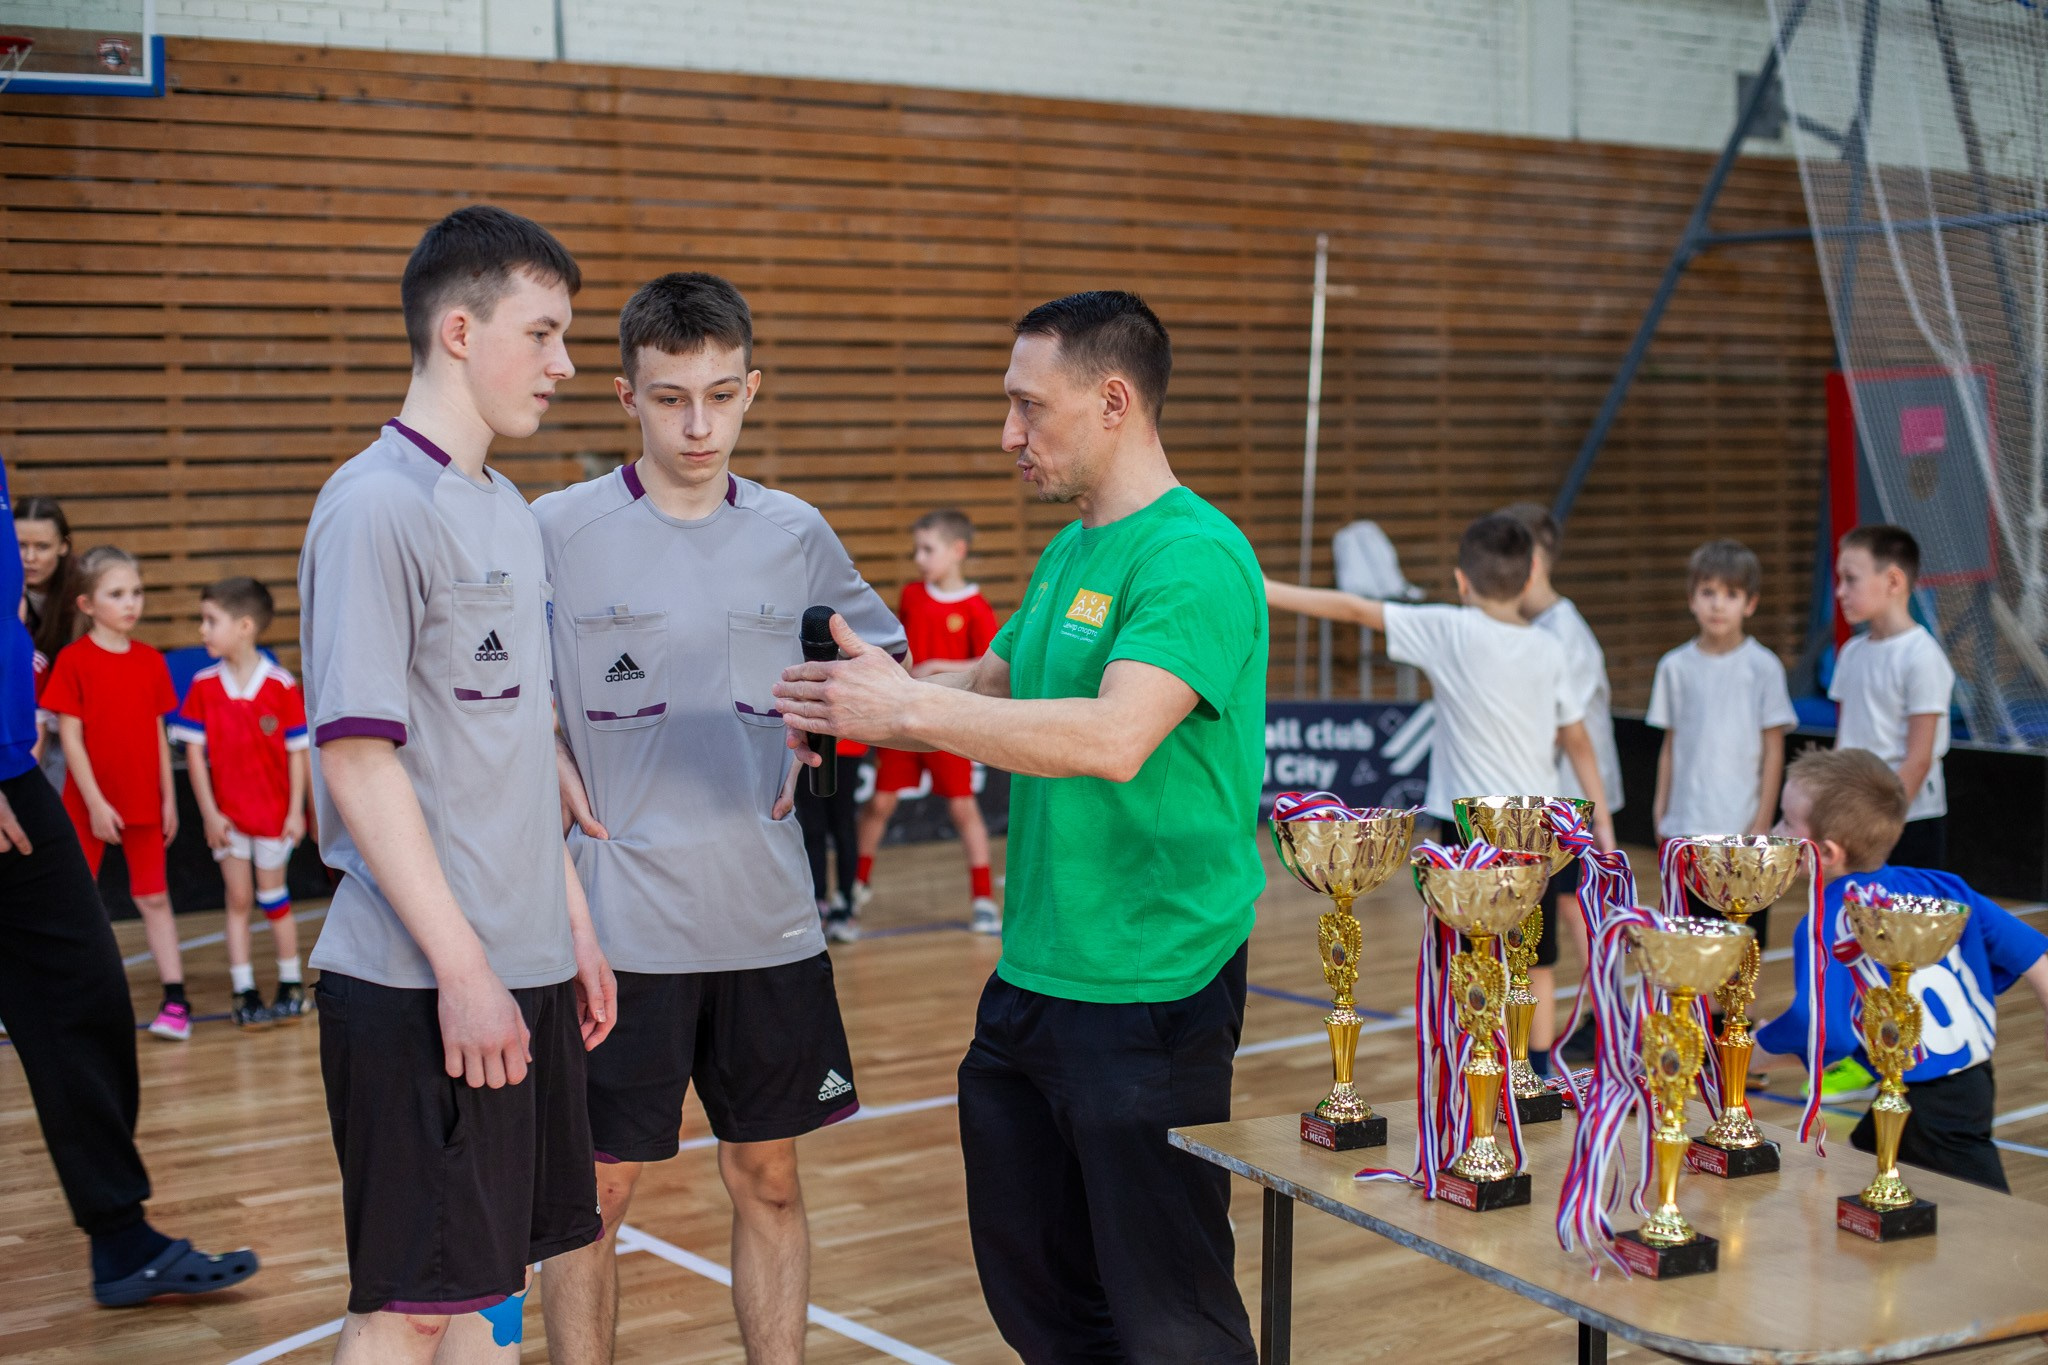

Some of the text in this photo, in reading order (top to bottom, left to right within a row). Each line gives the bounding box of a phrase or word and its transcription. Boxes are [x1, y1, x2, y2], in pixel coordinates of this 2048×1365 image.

[474, 650, 509, 662] adidas
[604, 669, 646, 683] adidas
[1305, 718, 1375, 751] club
[1274, 753, 1340, 790] City
[817, 1082, 853, 1102] adidas
[1310, 1133, 1331, 1147] МЕСТО
[1700, 1160, 1722, 1174] МЕСТО
[1449, 1192, 1472, 1207] МЕСТО
